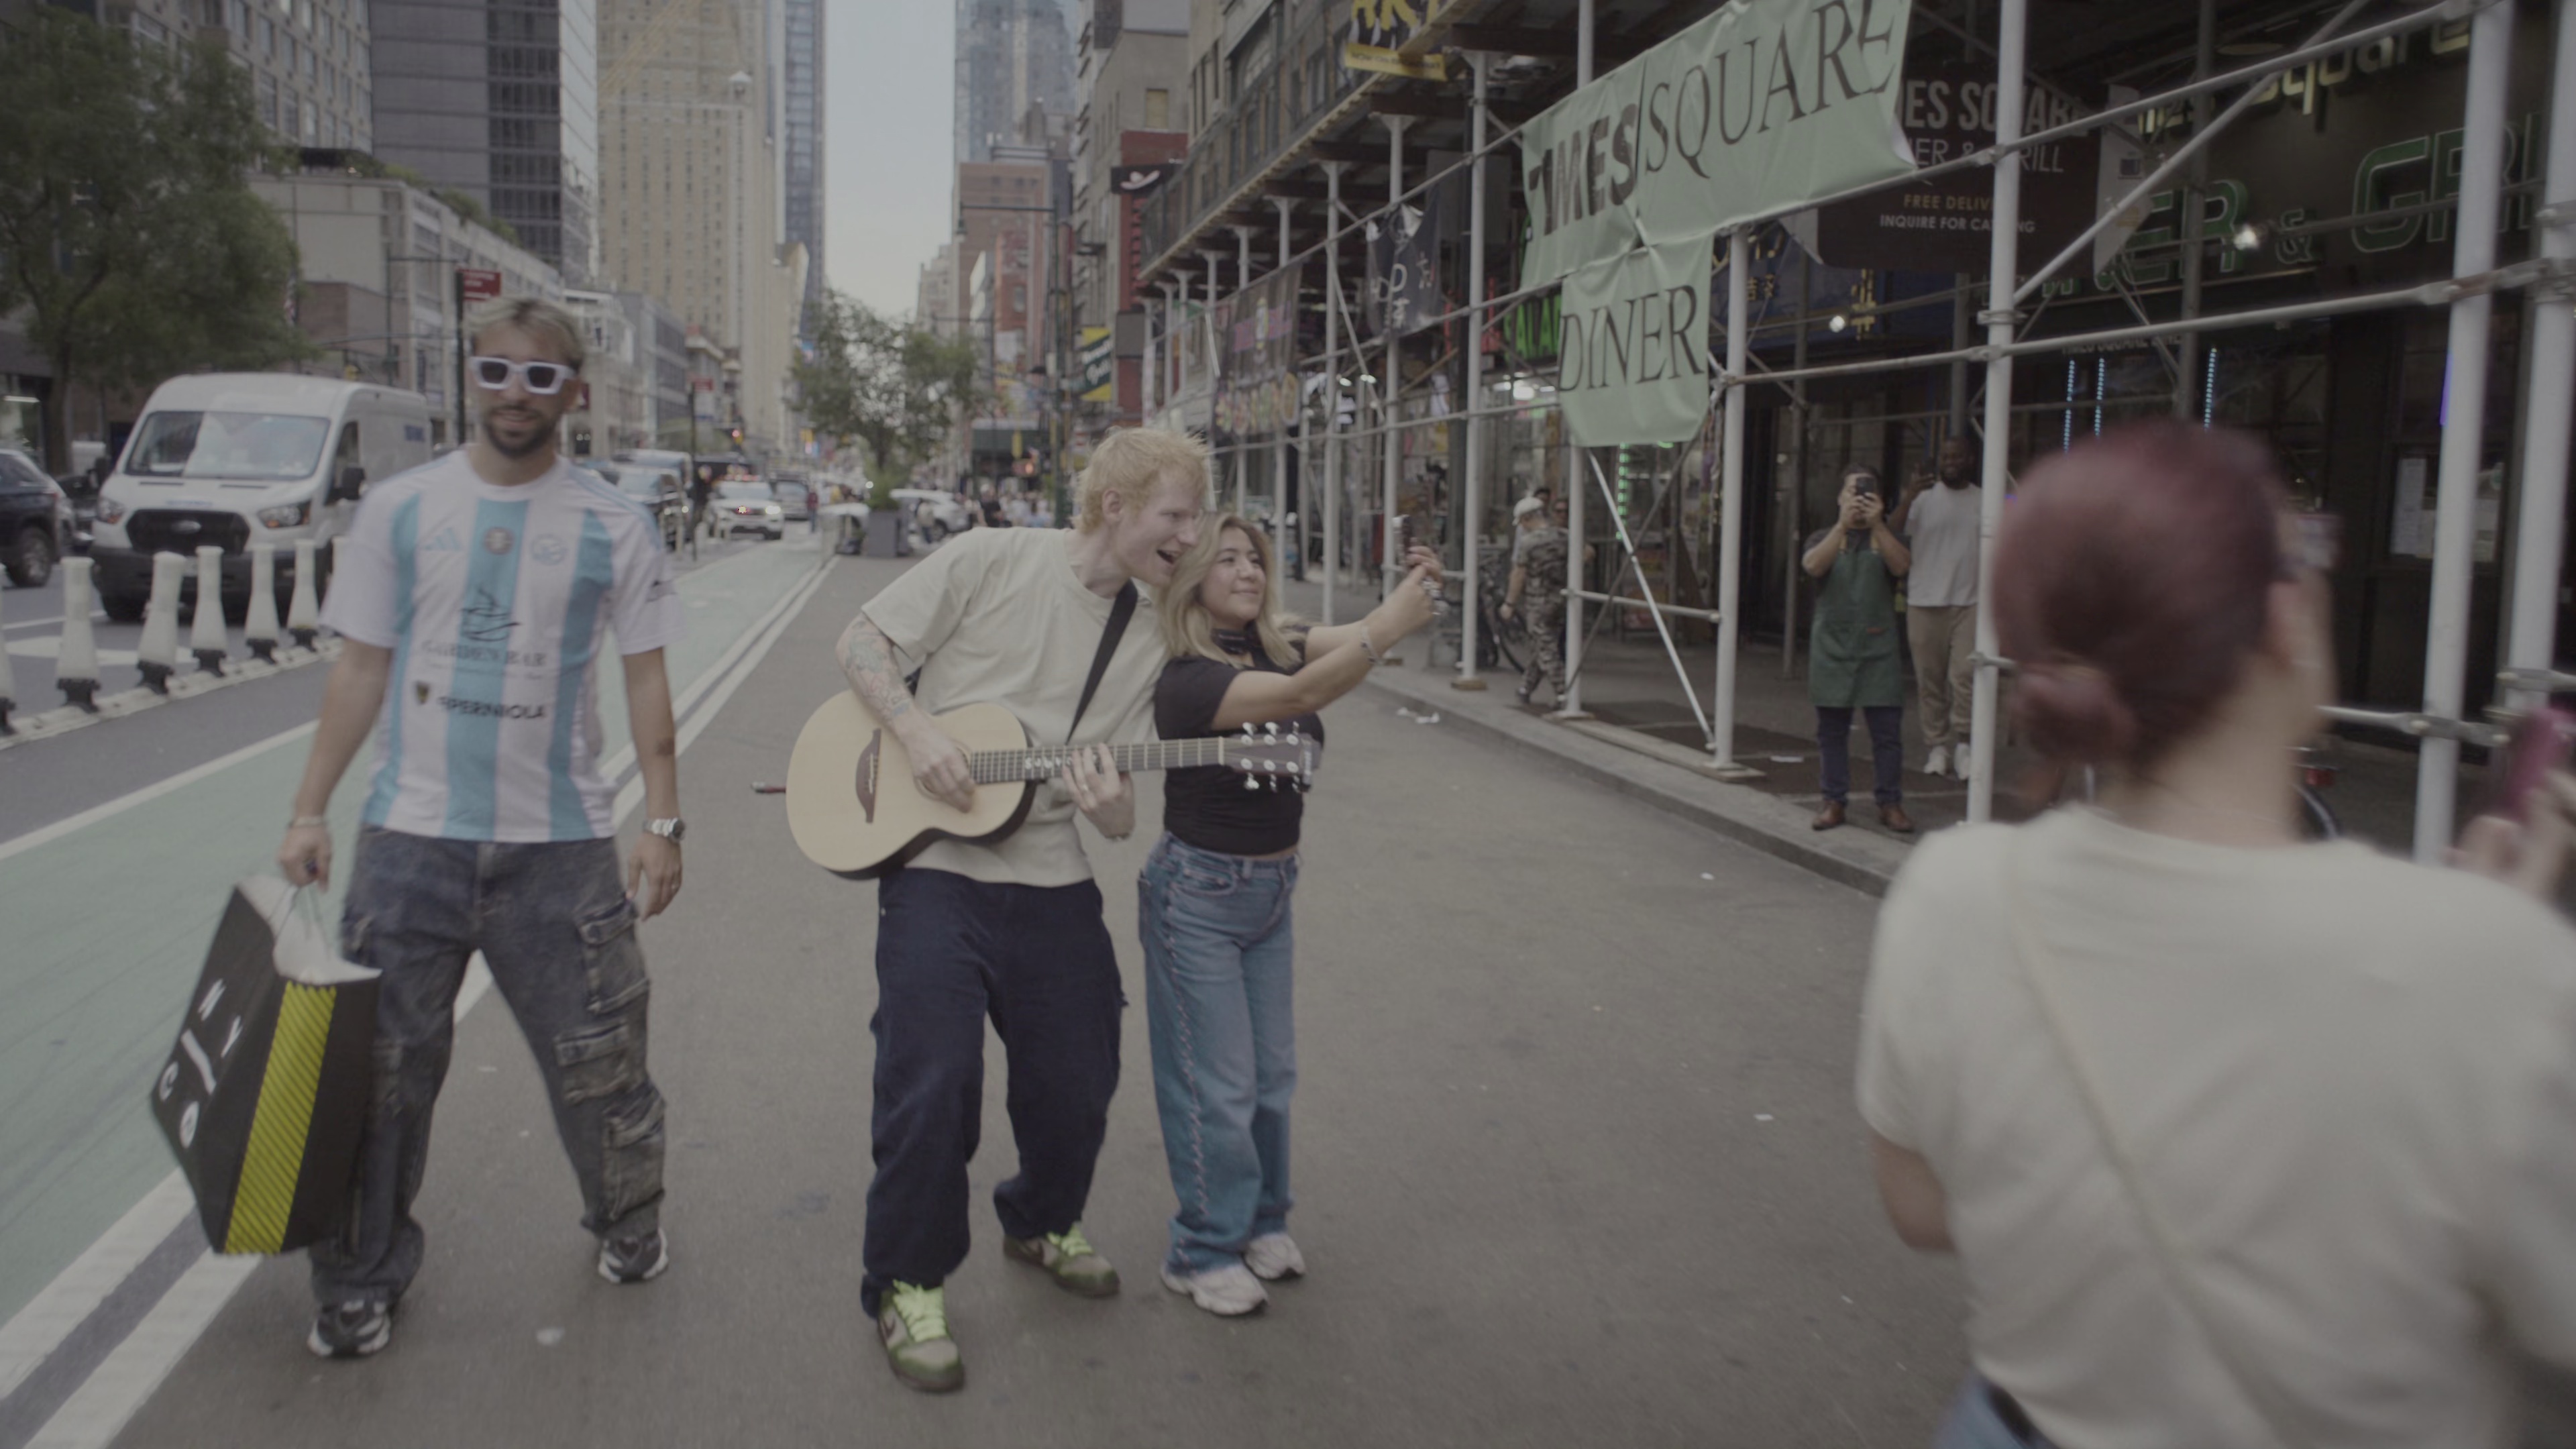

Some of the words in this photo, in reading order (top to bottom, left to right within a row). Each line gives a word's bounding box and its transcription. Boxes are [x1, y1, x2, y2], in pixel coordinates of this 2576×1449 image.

[1903, 194, 1941, 210] FREE
[1880, 214, 1935, 229] INQUIRE
[1940, 216, 1967, 230] FOR
[1558, 285, 1705, 392] DINER
